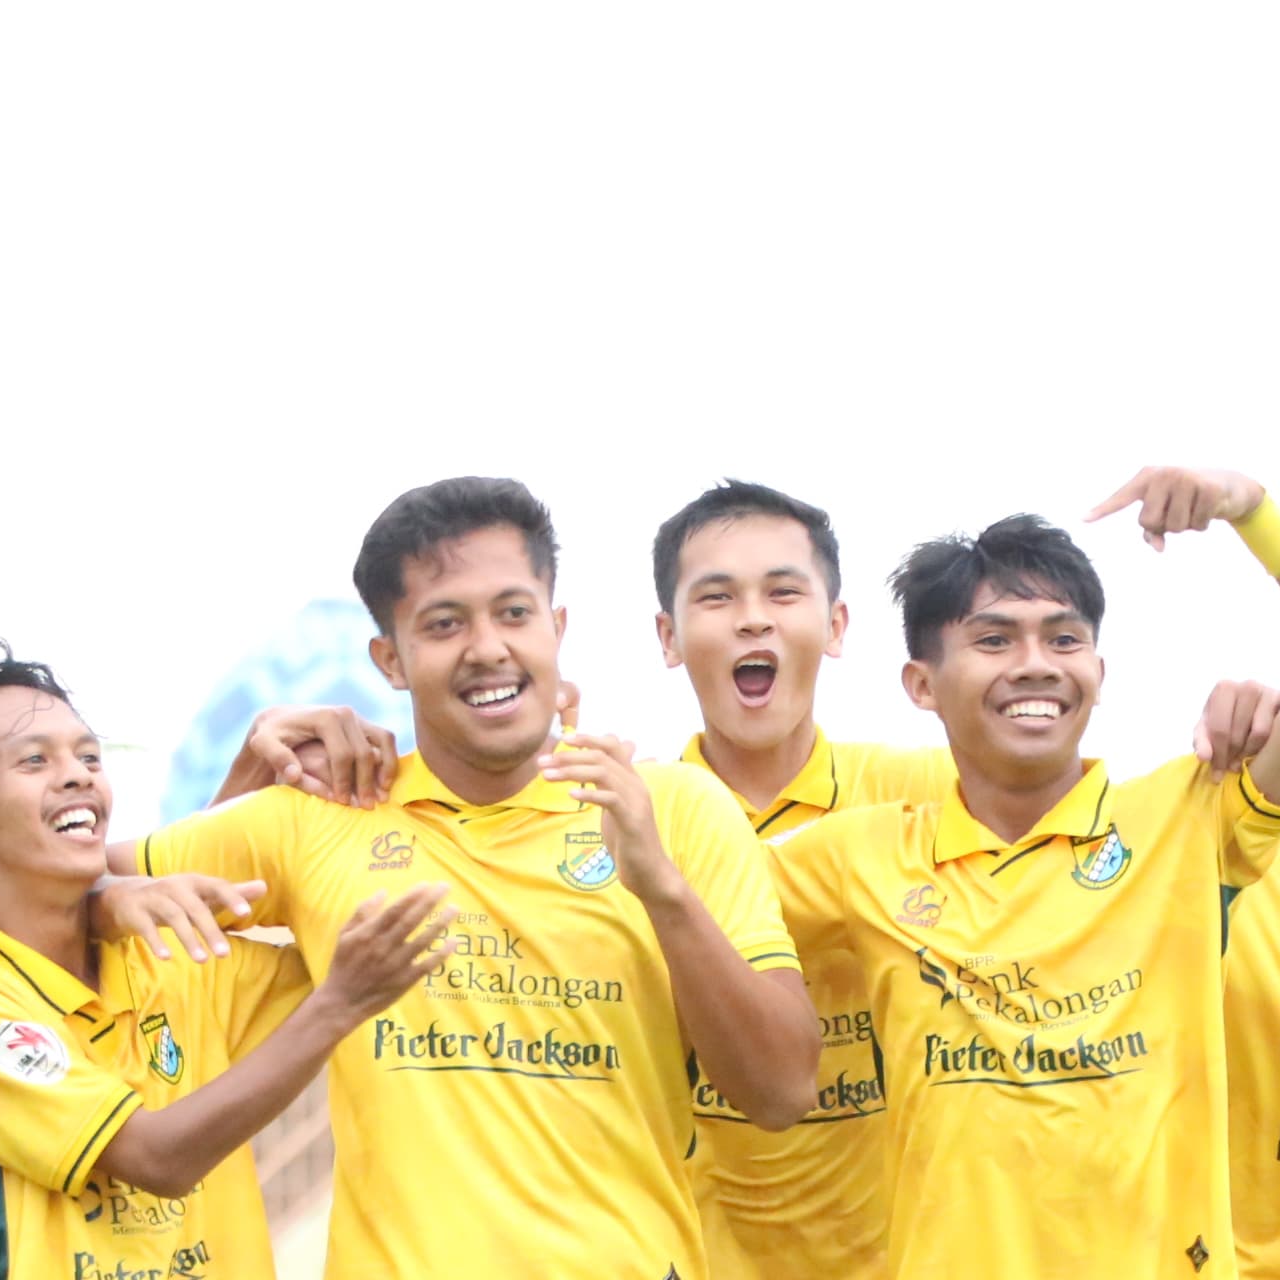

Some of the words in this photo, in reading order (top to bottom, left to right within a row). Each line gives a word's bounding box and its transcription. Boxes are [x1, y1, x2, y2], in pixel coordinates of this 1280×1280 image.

[456, 912, 488, 925] BPR
[424, 962, 624, 1010] Pekalongan
[964, 955, 995, 971] BPR
[425, 989, 469, 1002] Menuju
[512, 996, 562, 1009] Bersama
[956, 968, 1144, 1024] Pekalongan
[373, 1017, 479, 1061] Pieter
[483, 1020, 622, 1072] Jackson
[924, 1033, 1008, 1077] Pieter
[1012, 1030, 1149, 1074] Jackson
